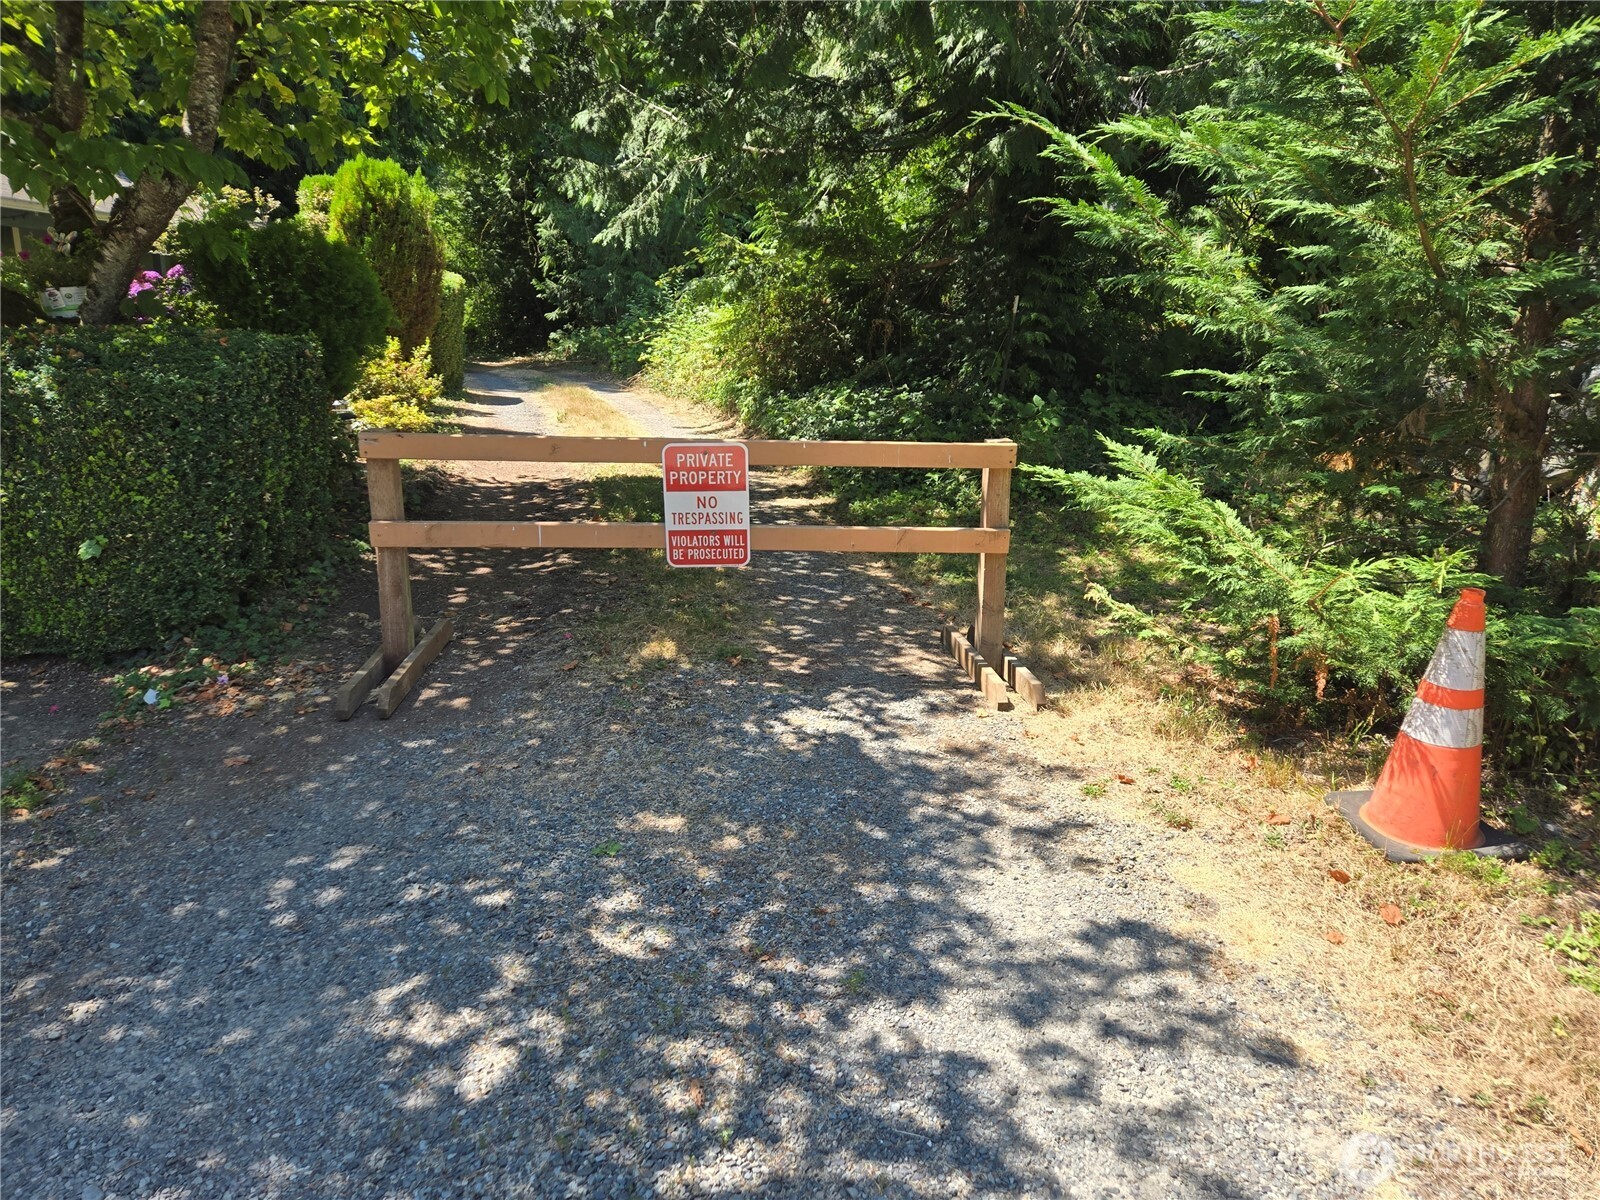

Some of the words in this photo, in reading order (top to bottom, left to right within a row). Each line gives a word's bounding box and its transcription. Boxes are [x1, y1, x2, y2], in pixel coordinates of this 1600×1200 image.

[676, 453, 734, 468] PRIVATE
[669, 470, 742, 485] PROPERTY
[696, 496, 718, 509] NO
[671, 512, 743, 525] TRESPASSING
[671, 535, 721, 547] VIOLATORS
[723, 535, 745, 546] WILL
[672, 549, 685, 560] BE
[687, 548, 745, 560] PROSECUTED
